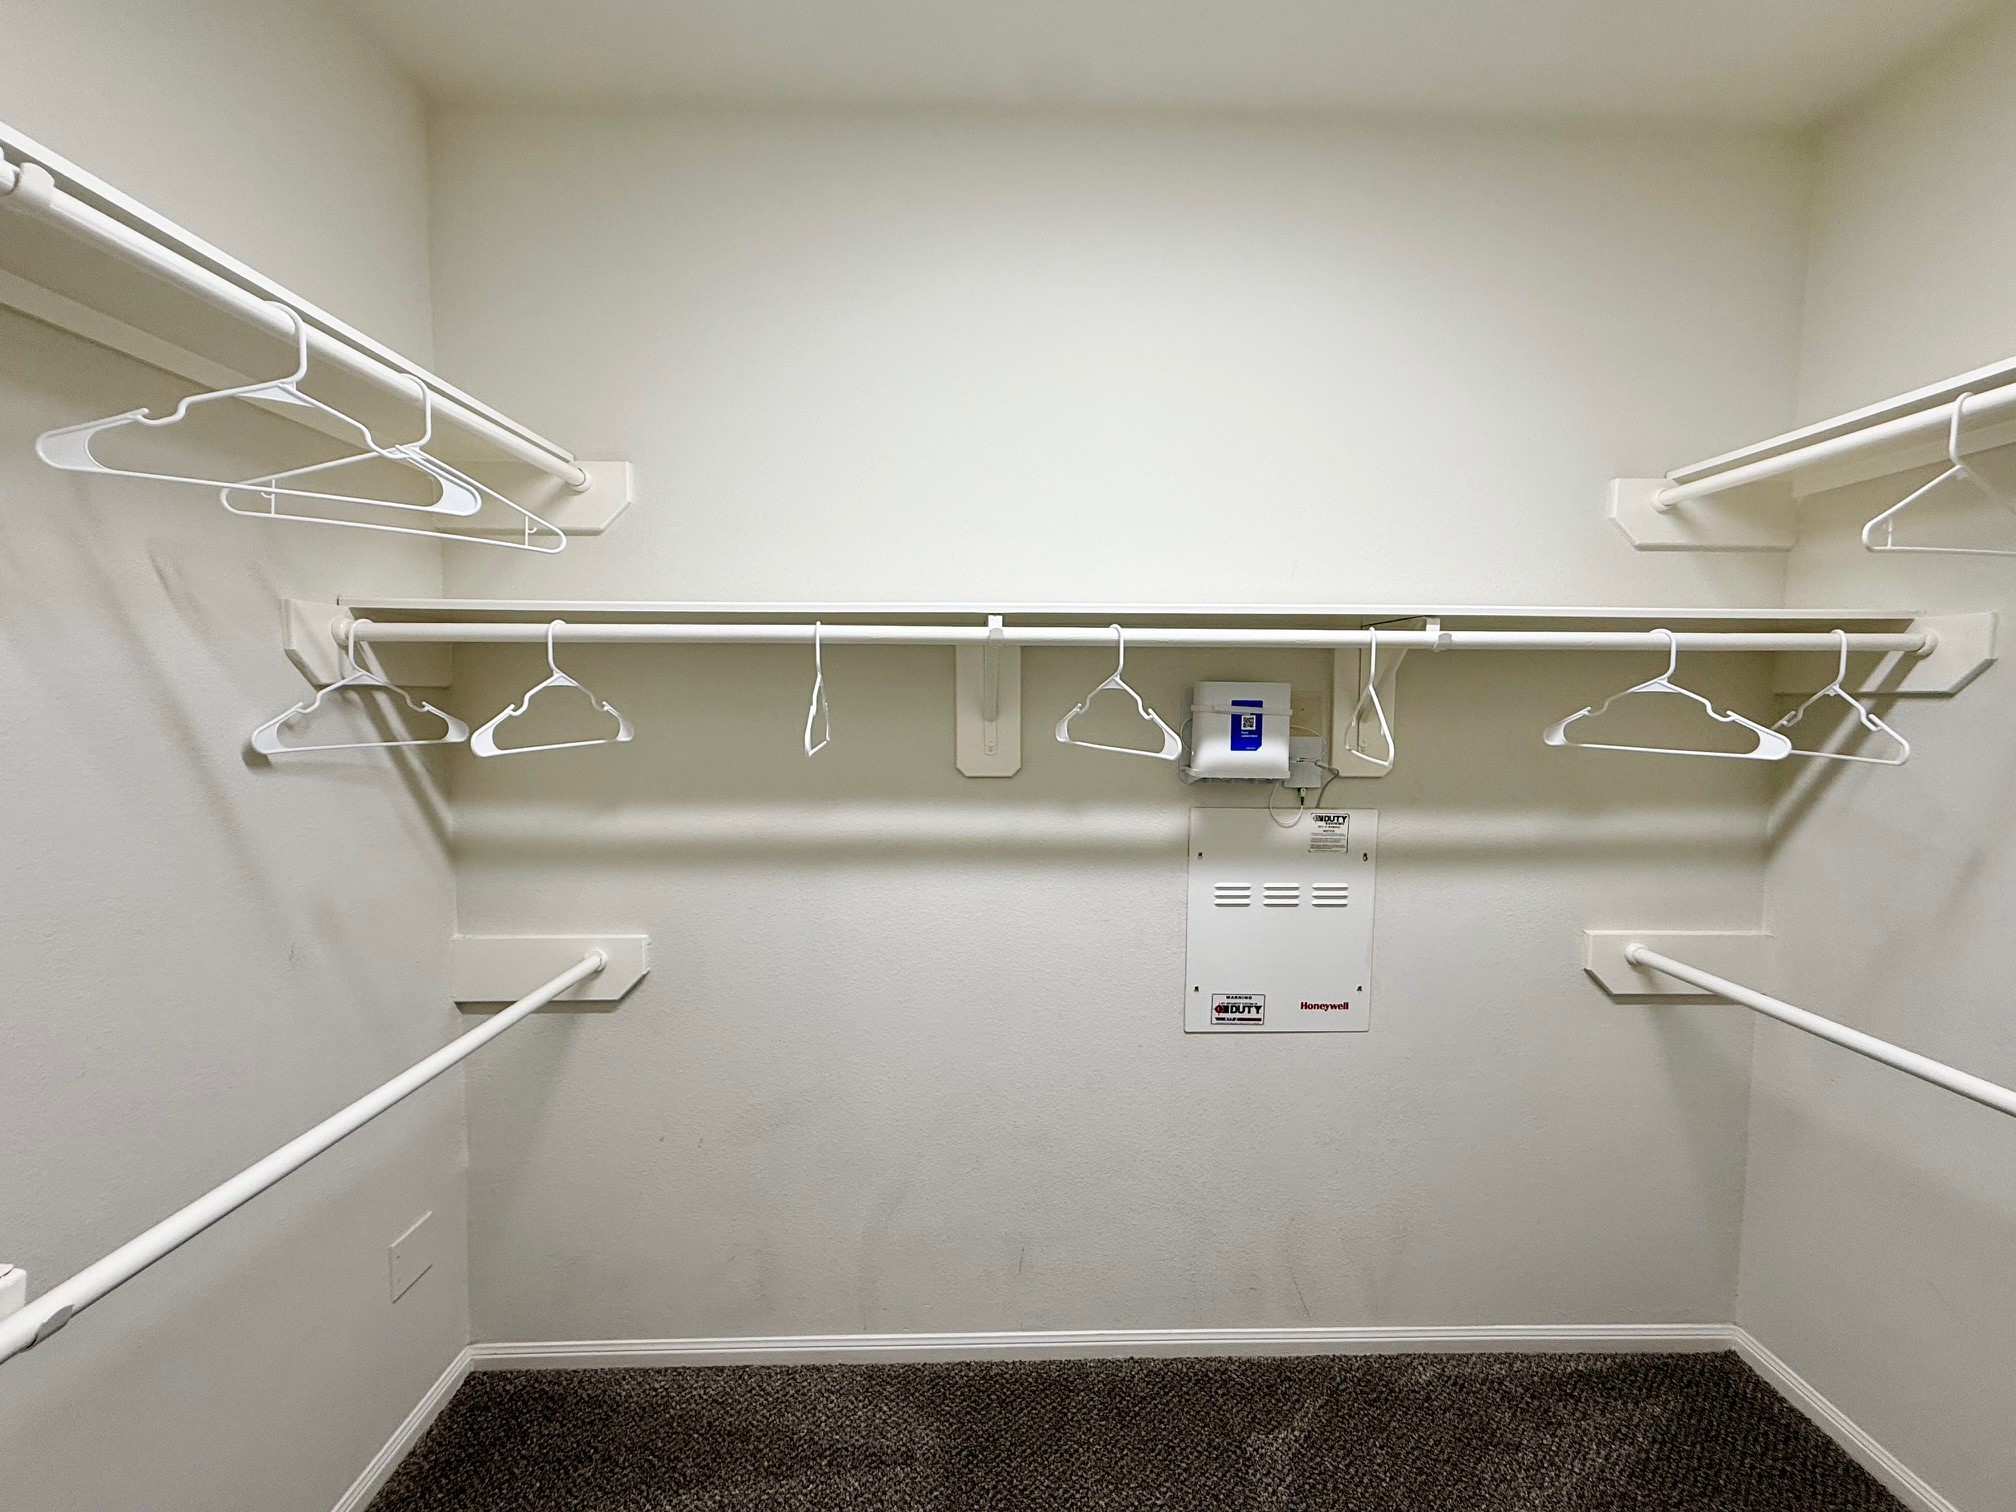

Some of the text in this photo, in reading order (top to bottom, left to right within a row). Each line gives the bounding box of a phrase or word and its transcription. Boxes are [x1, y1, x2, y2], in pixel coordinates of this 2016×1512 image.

[1324, 815, 1347, 823] DUTY
[1230, 1004, 1262, 1014] DUTY
[1300, 1001, 1349, 1012] Honeywell
